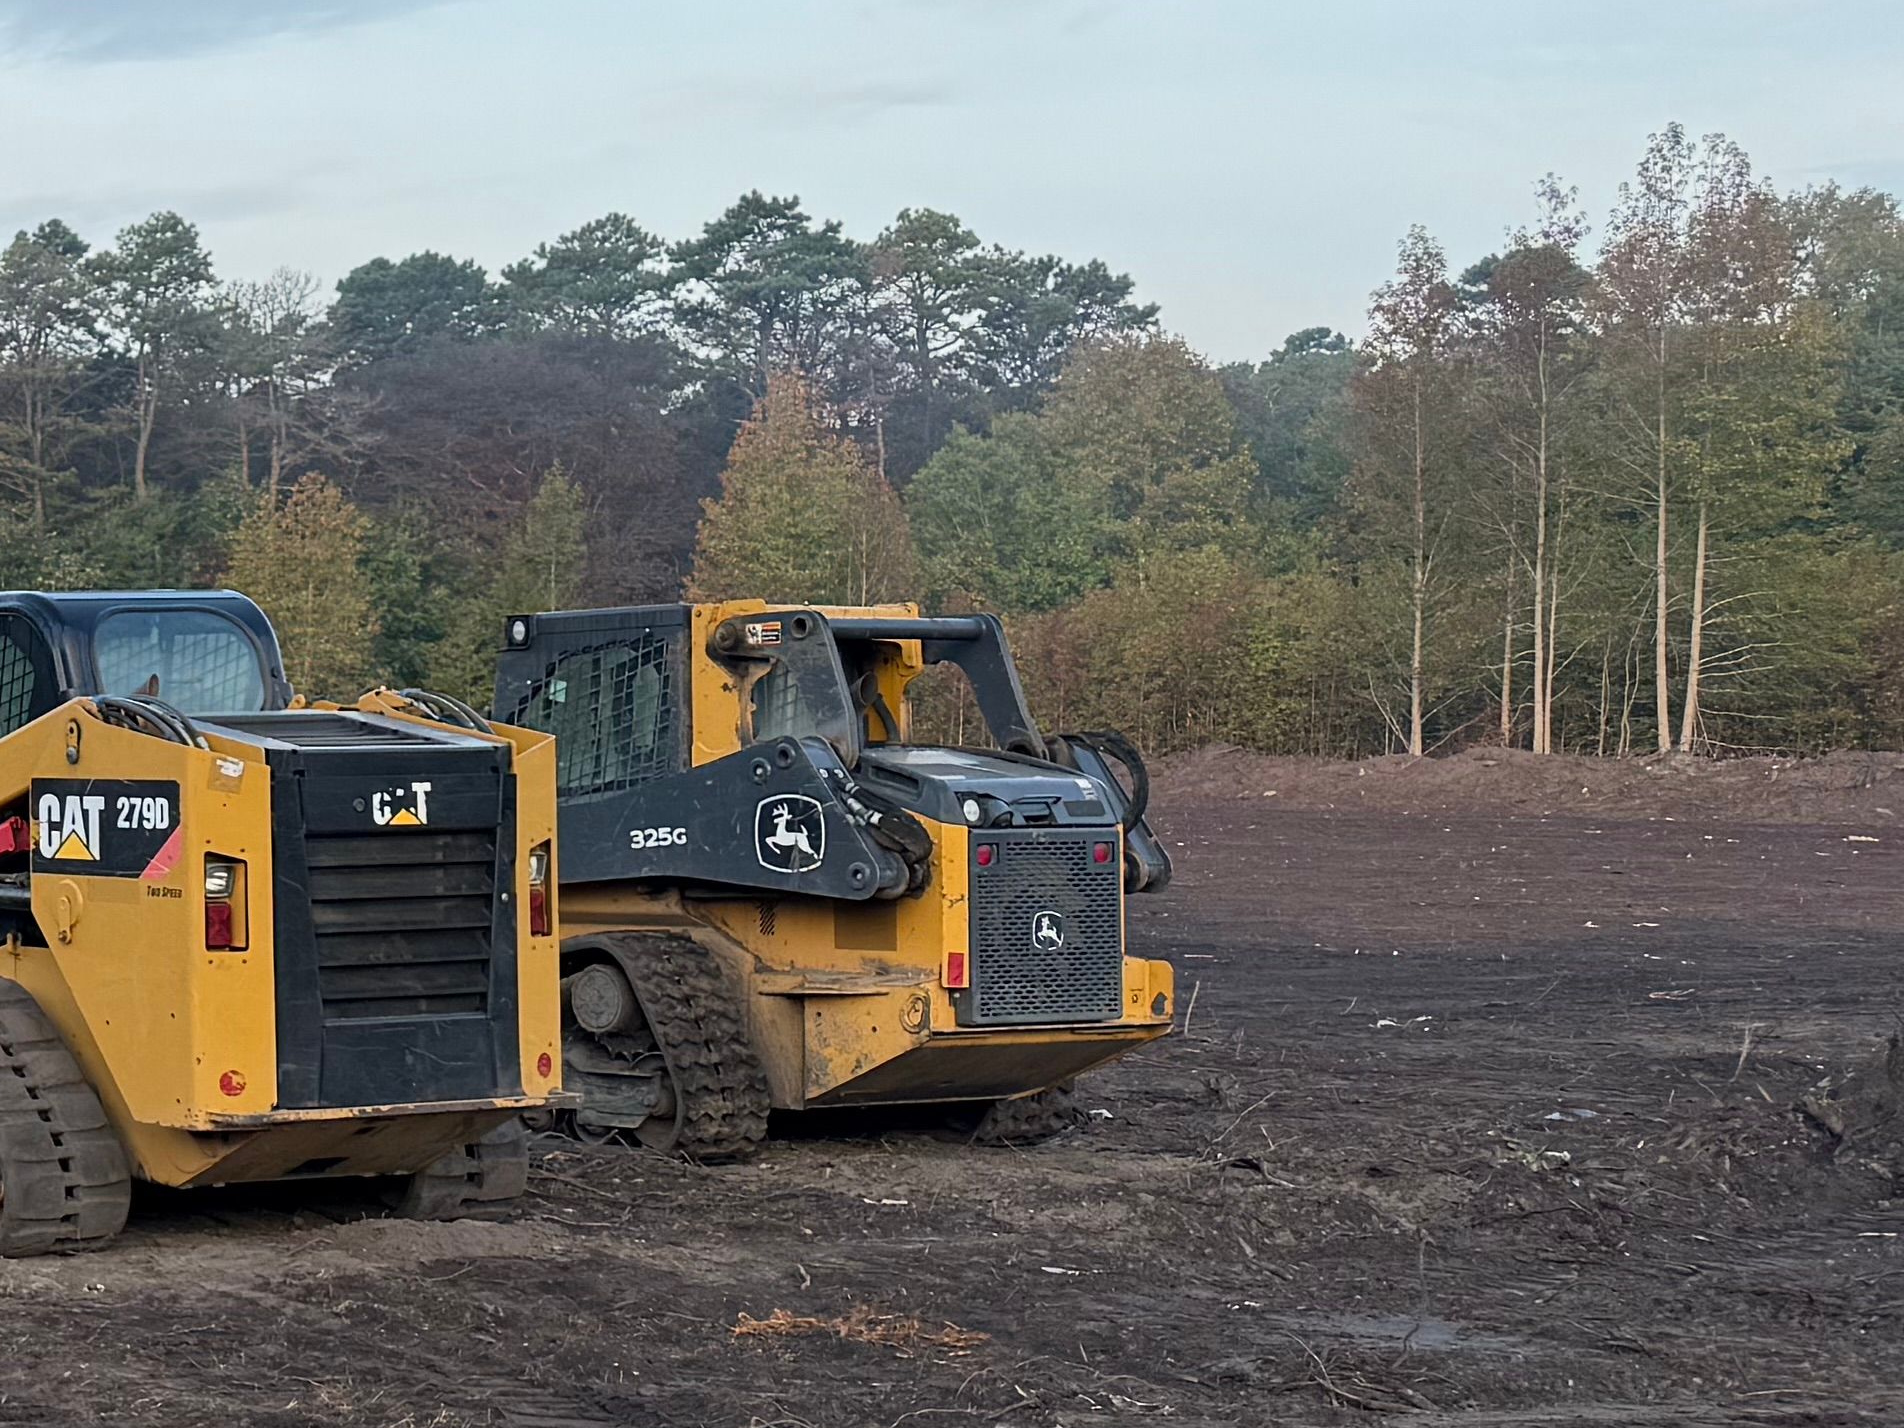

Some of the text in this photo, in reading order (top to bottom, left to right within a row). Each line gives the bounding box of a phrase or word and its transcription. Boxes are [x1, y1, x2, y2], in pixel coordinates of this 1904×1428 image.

[372, 781, 432, 826] CT
[38, 793, 170, 861] CAT 279D
[629, 826, 688, 849] 325G
